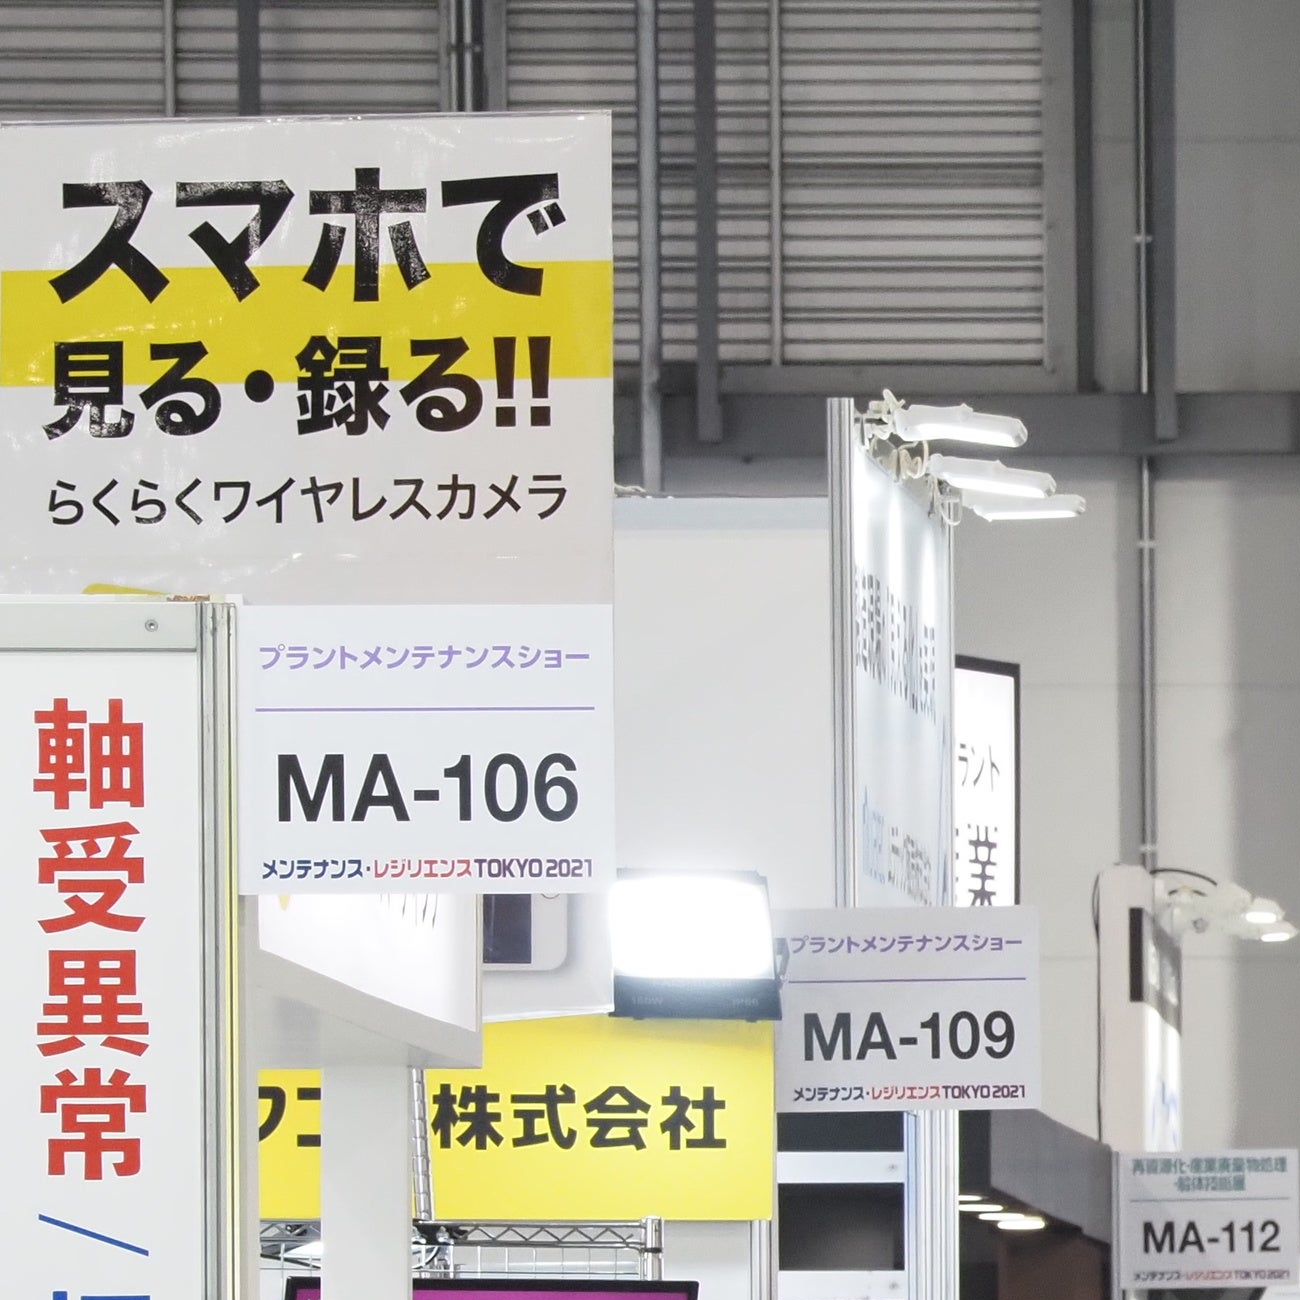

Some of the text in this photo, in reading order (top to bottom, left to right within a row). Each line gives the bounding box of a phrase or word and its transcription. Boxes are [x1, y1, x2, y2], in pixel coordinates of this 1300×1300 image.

[49, 167, 566, 304] スマホで
[48, 473, 567, 525] らくらくワイヤレスカメラ
[259, 643, 591, 670] プラントメンテナンスショー
[277, 753, 579, 823] MA-106
[955, 824, 998, 906] 業
[790, 934, 1022, 955] プラントメンテナンスショー
[803, 1010, 1016, 1062] MA-109
[431, 1083, 727, 1151] 株式会社
[1143, 1220, 1281, 1254] MA-112
